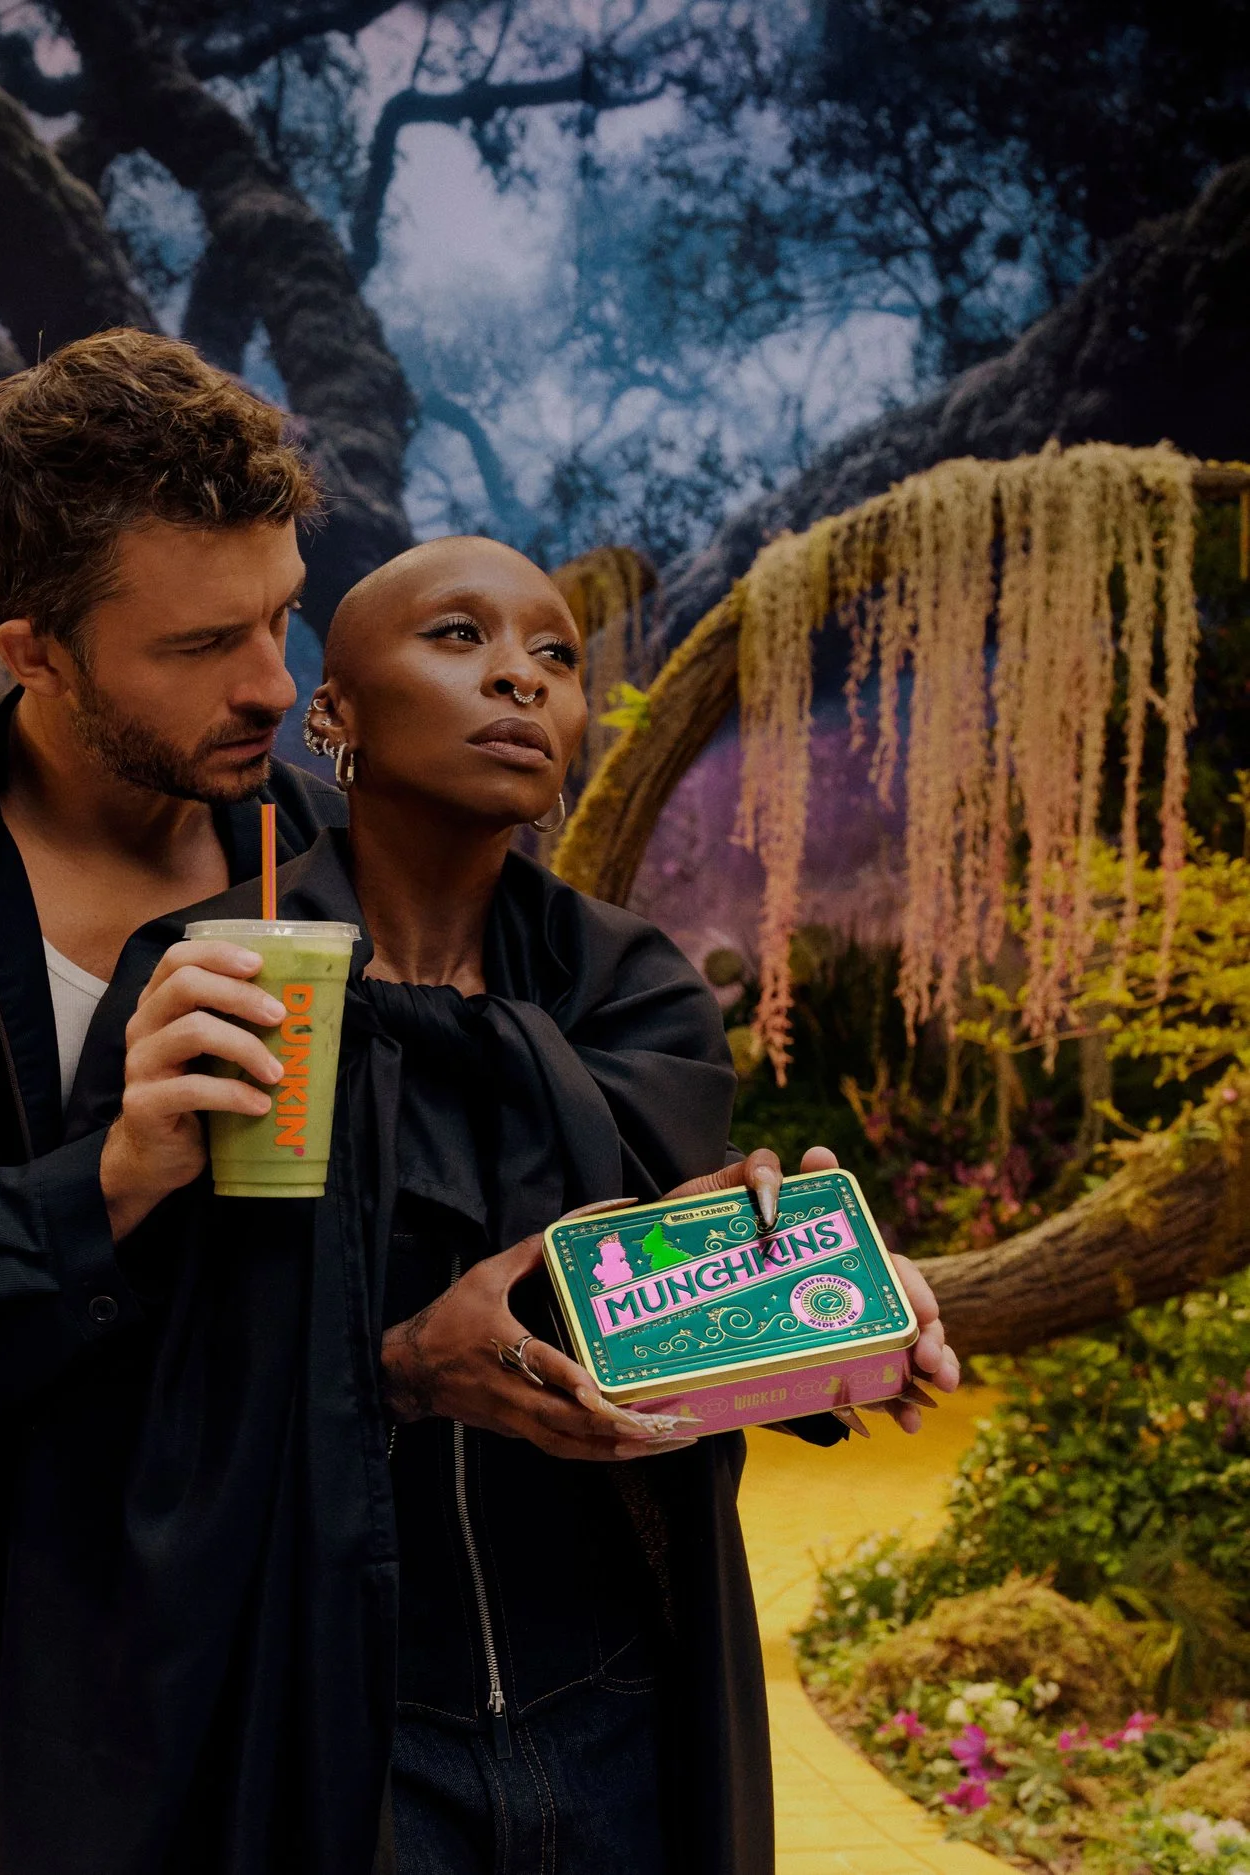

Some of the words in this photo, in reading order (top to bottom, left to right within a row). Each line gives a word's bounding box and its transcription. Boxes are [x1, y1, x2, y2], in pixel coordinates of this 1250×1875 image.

[274, 984, 315, 1157] DUNKIN'
[605, 1220, 843, 1328] MUNCHKINS
[794, 1276, 853, 1300] CERTIFICATION
[808, 1318, 835, 1328] MADE
[838, 1319, 848, 1327] IN
[848, 1310, 859, 1321] OZ
[734, 1387, 788, 1411] WICKED
